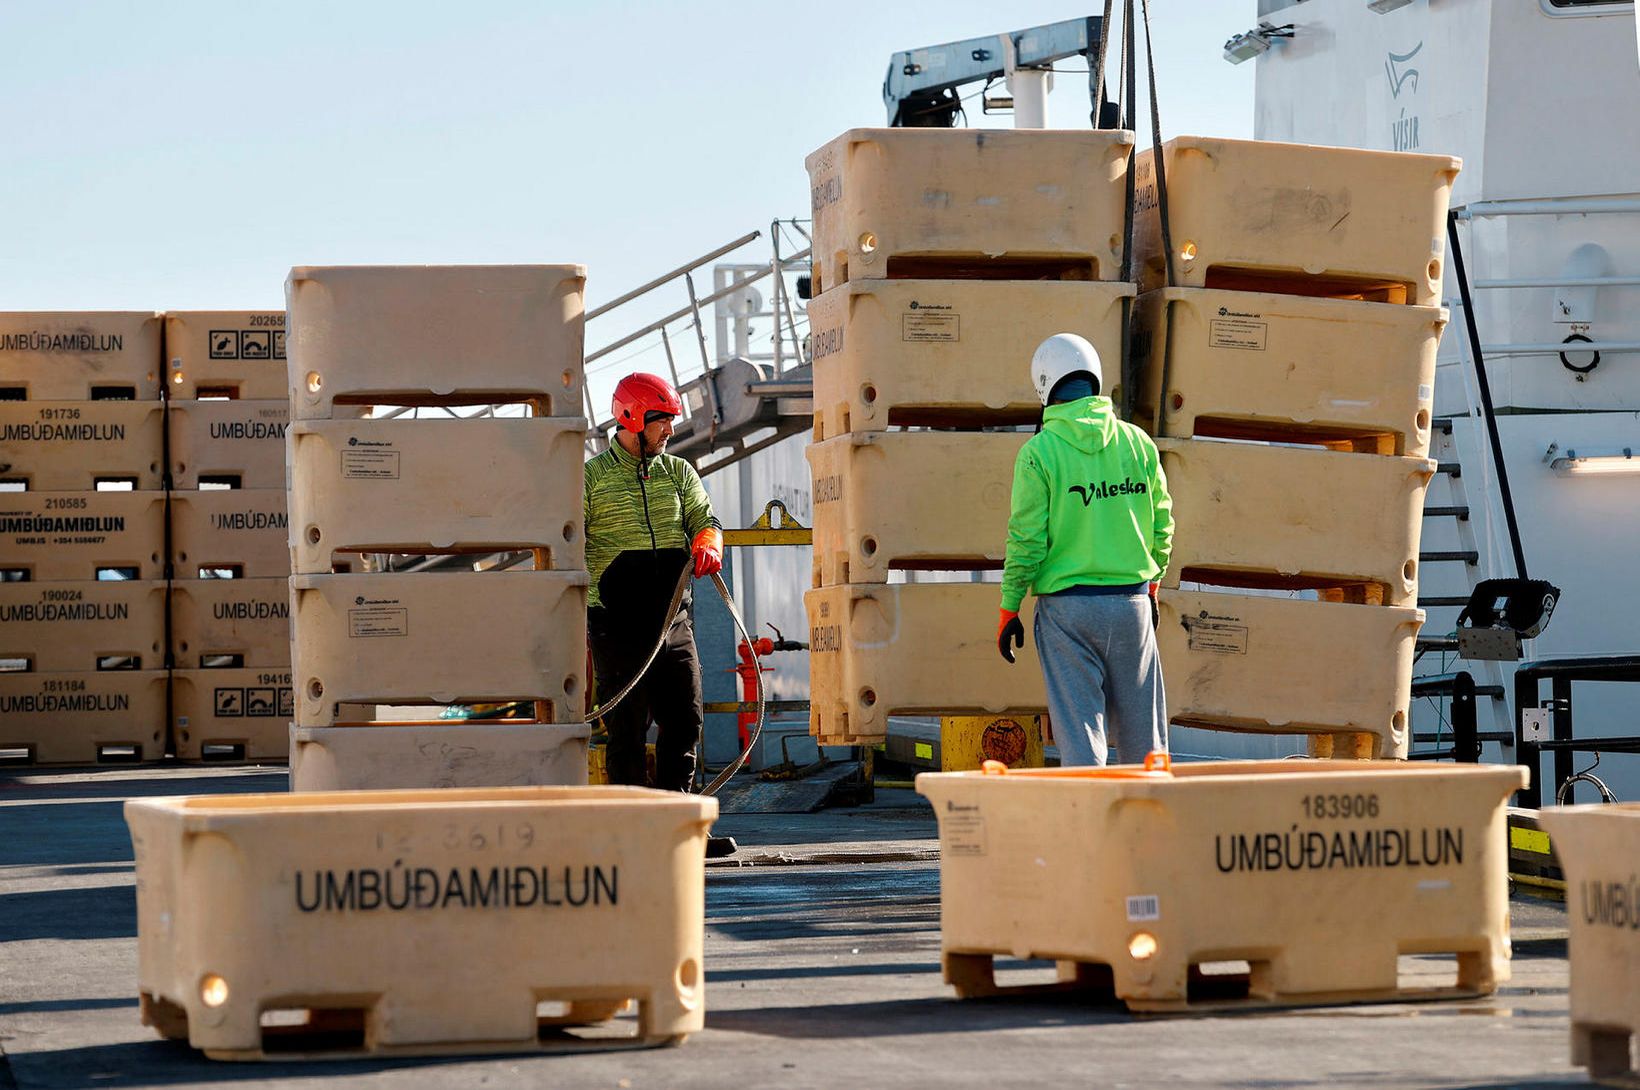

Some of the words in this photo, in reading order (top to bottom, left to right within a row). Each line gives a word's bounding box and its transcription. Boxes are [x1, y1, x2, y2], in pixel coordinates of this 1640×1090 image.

[1392, 107, 1419, 151] VÍSIR
[250, 314, 286, 326] 20265
[40, 408, 80, 419] 191736
[45, 498, 87, 509] 210585
[42, 590, 82, 601] 190024
[0, 600, 128, 621] UMBÚÐAMIÐLUN
[257, 674, 293, 685] 19416
[0, 692, 129, 712] UMBÚÐAMIÐLUN
[1301, 794, 1380, 818] 183906
[1215, 824, 1464, 873] UMBÚÐAMIÐLUN
[295, 858, 618, 912] UMBÚÐAMIÐLUN
